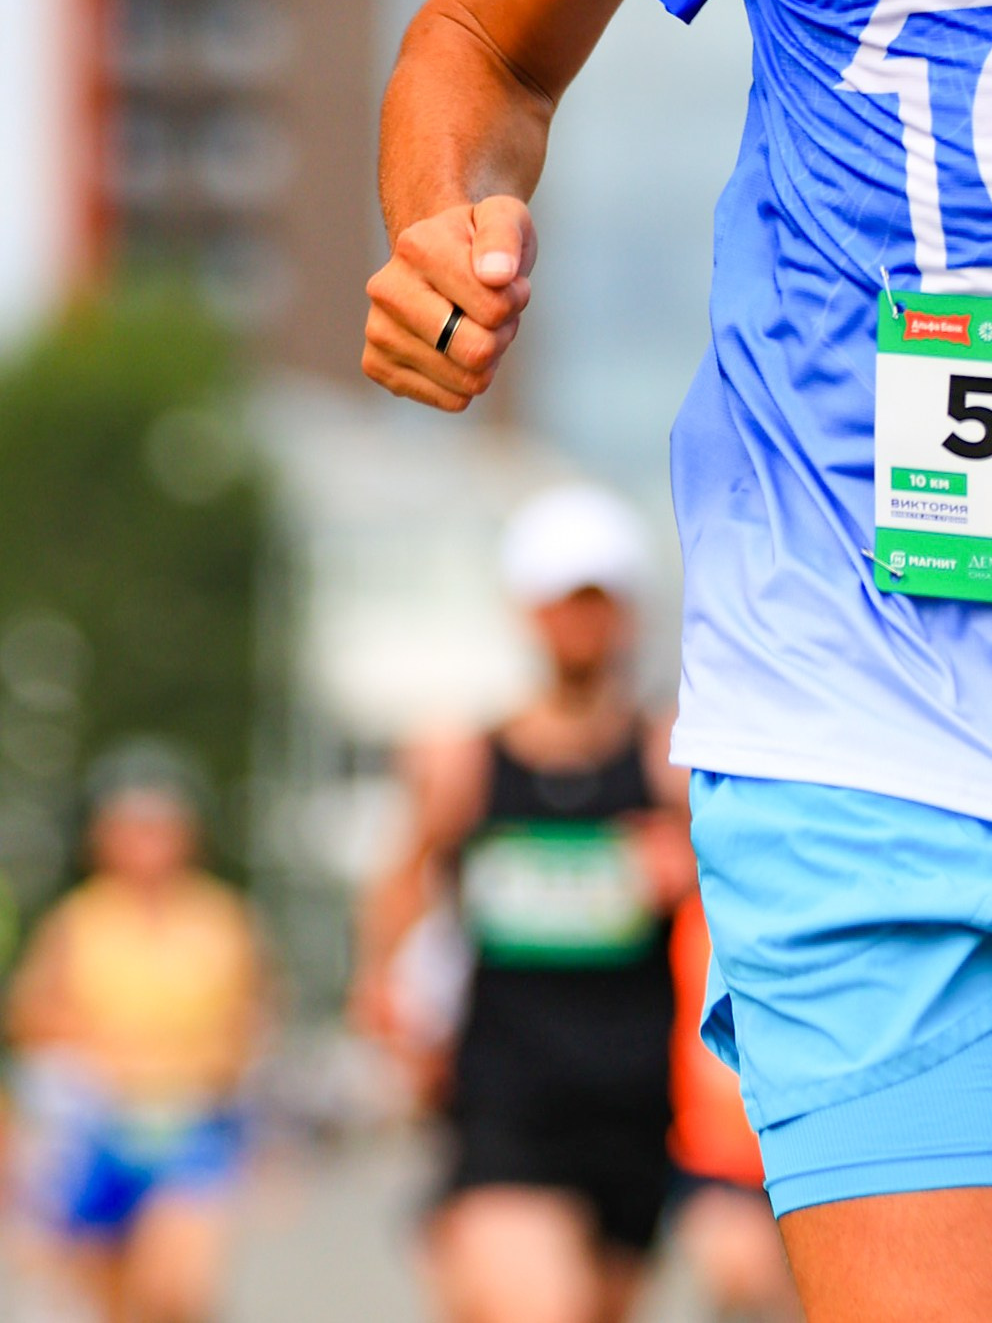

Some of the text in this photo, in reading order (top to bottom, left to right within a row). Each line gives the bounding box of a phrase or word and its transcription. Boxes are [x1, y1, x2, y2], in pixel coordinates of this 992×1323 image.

[909, 474, 927, 488] 10
[890, 498, 968, 514] ВИКТОРИЯ
[909, 555, 957, 570] МАГНИТ
